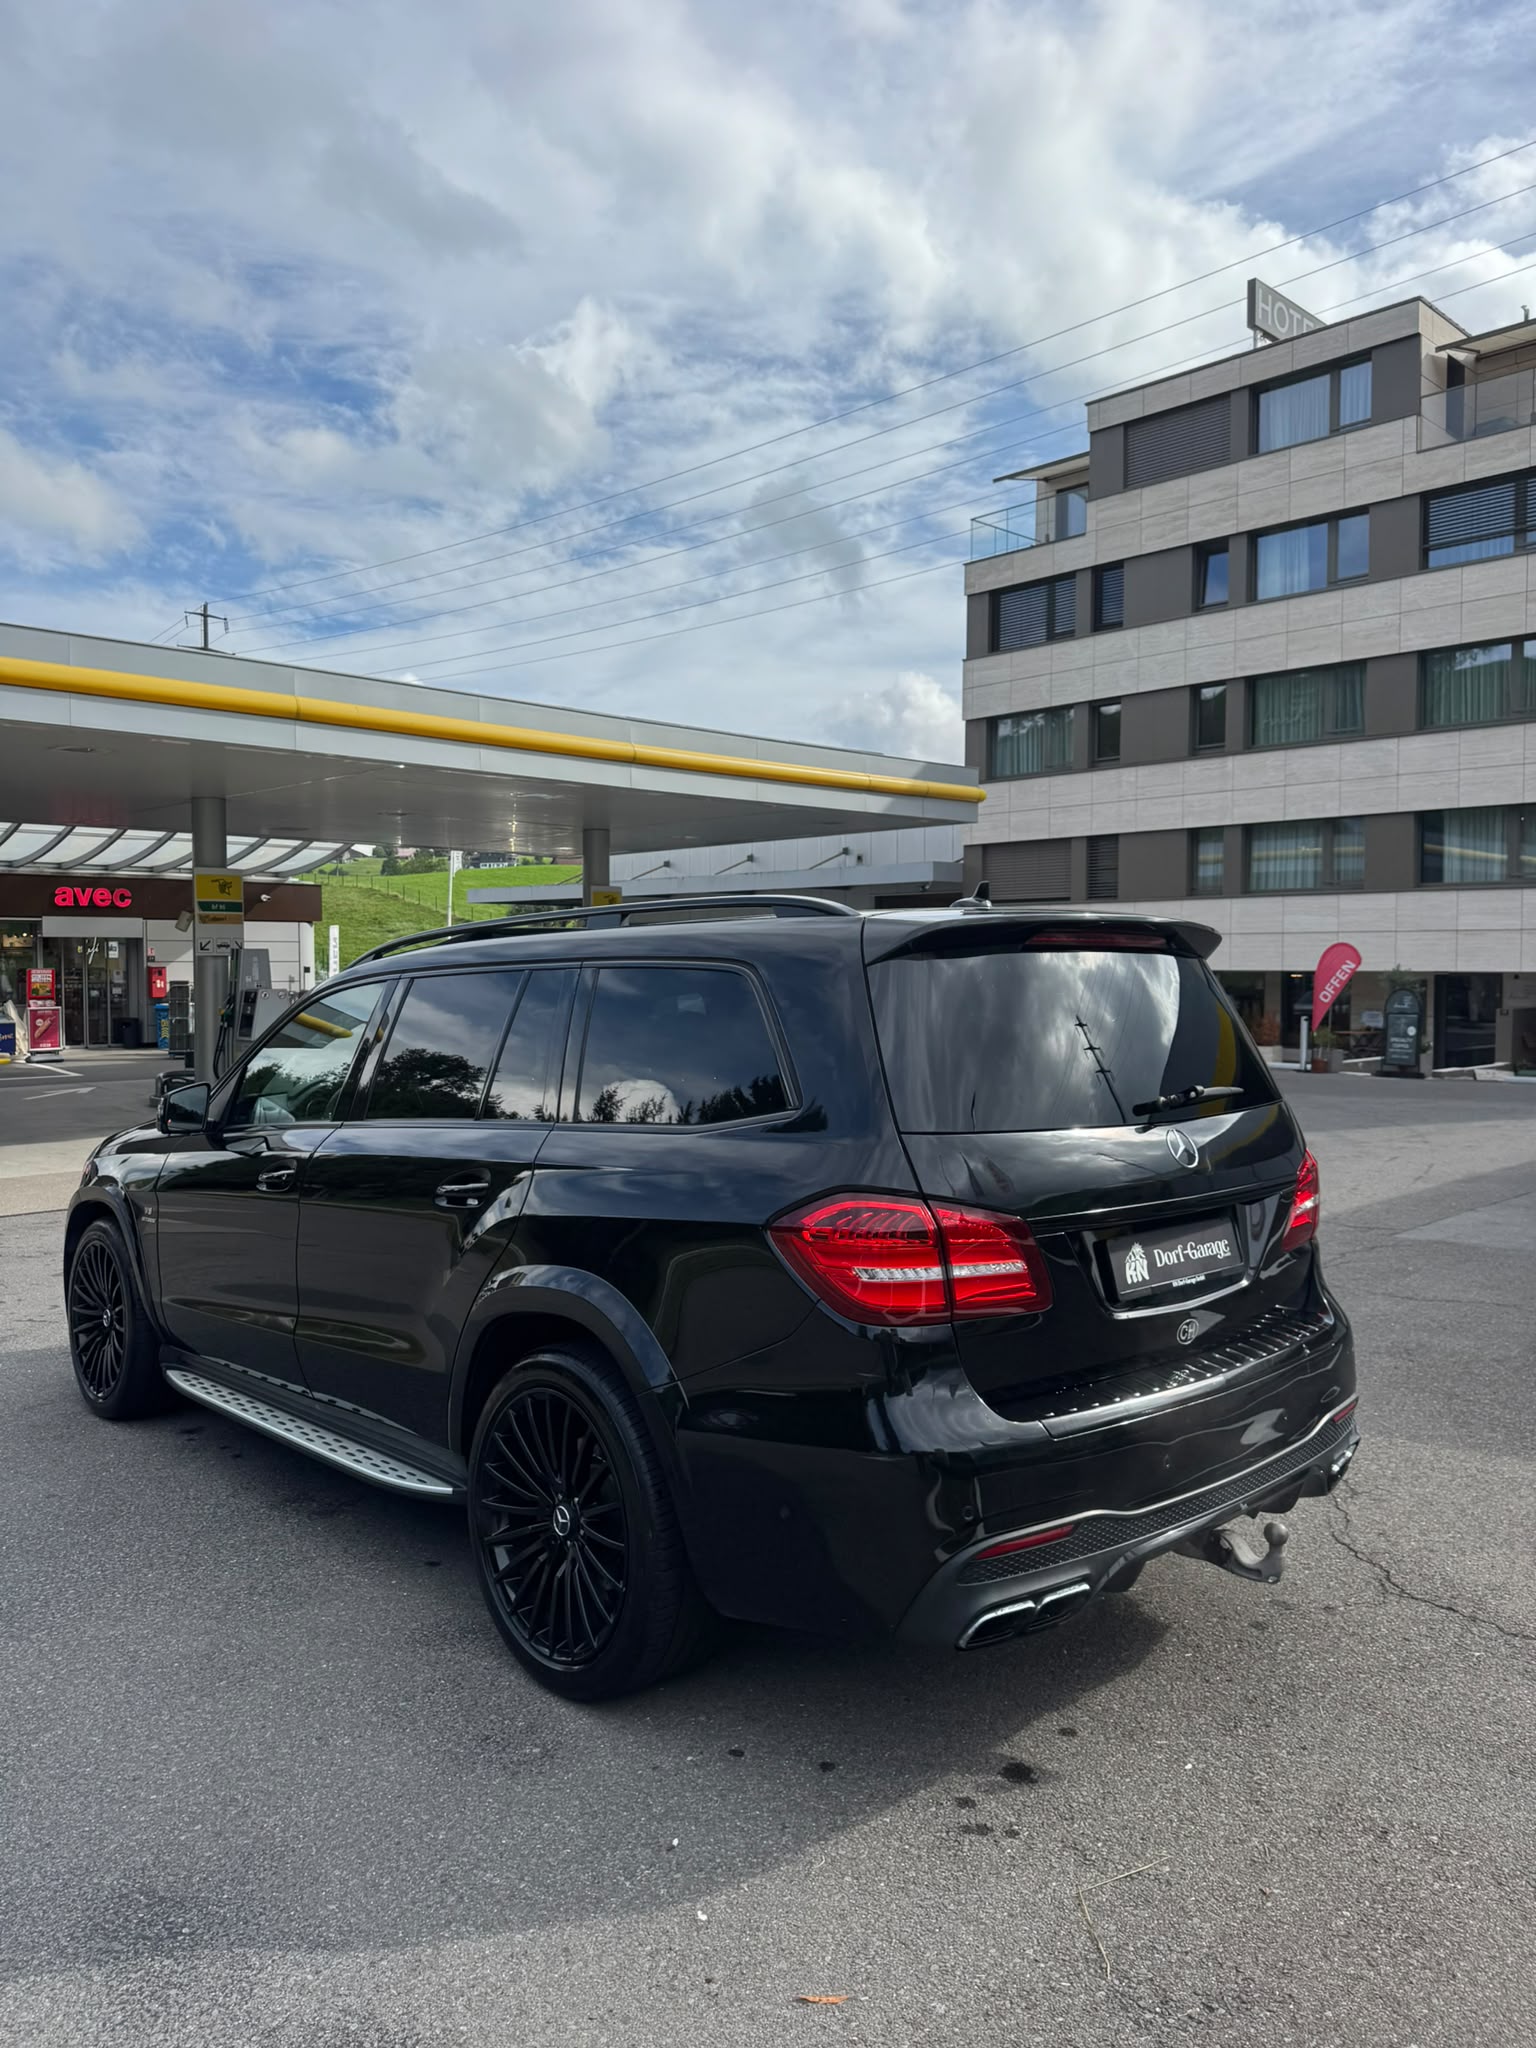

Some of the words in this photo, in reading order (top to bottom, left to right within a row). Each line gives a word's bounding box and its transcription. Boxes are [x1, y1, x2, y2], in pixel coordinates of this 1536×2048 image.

[1258, 287, 1315, 336] HOT
[54, 886, 132, 908] avec
[1319, 960, 1356, 1003] OFFEN
[1153, 1239, 1231, 1268] Dorf-Garage
[1180, 1322, 1196, 1340] CH
